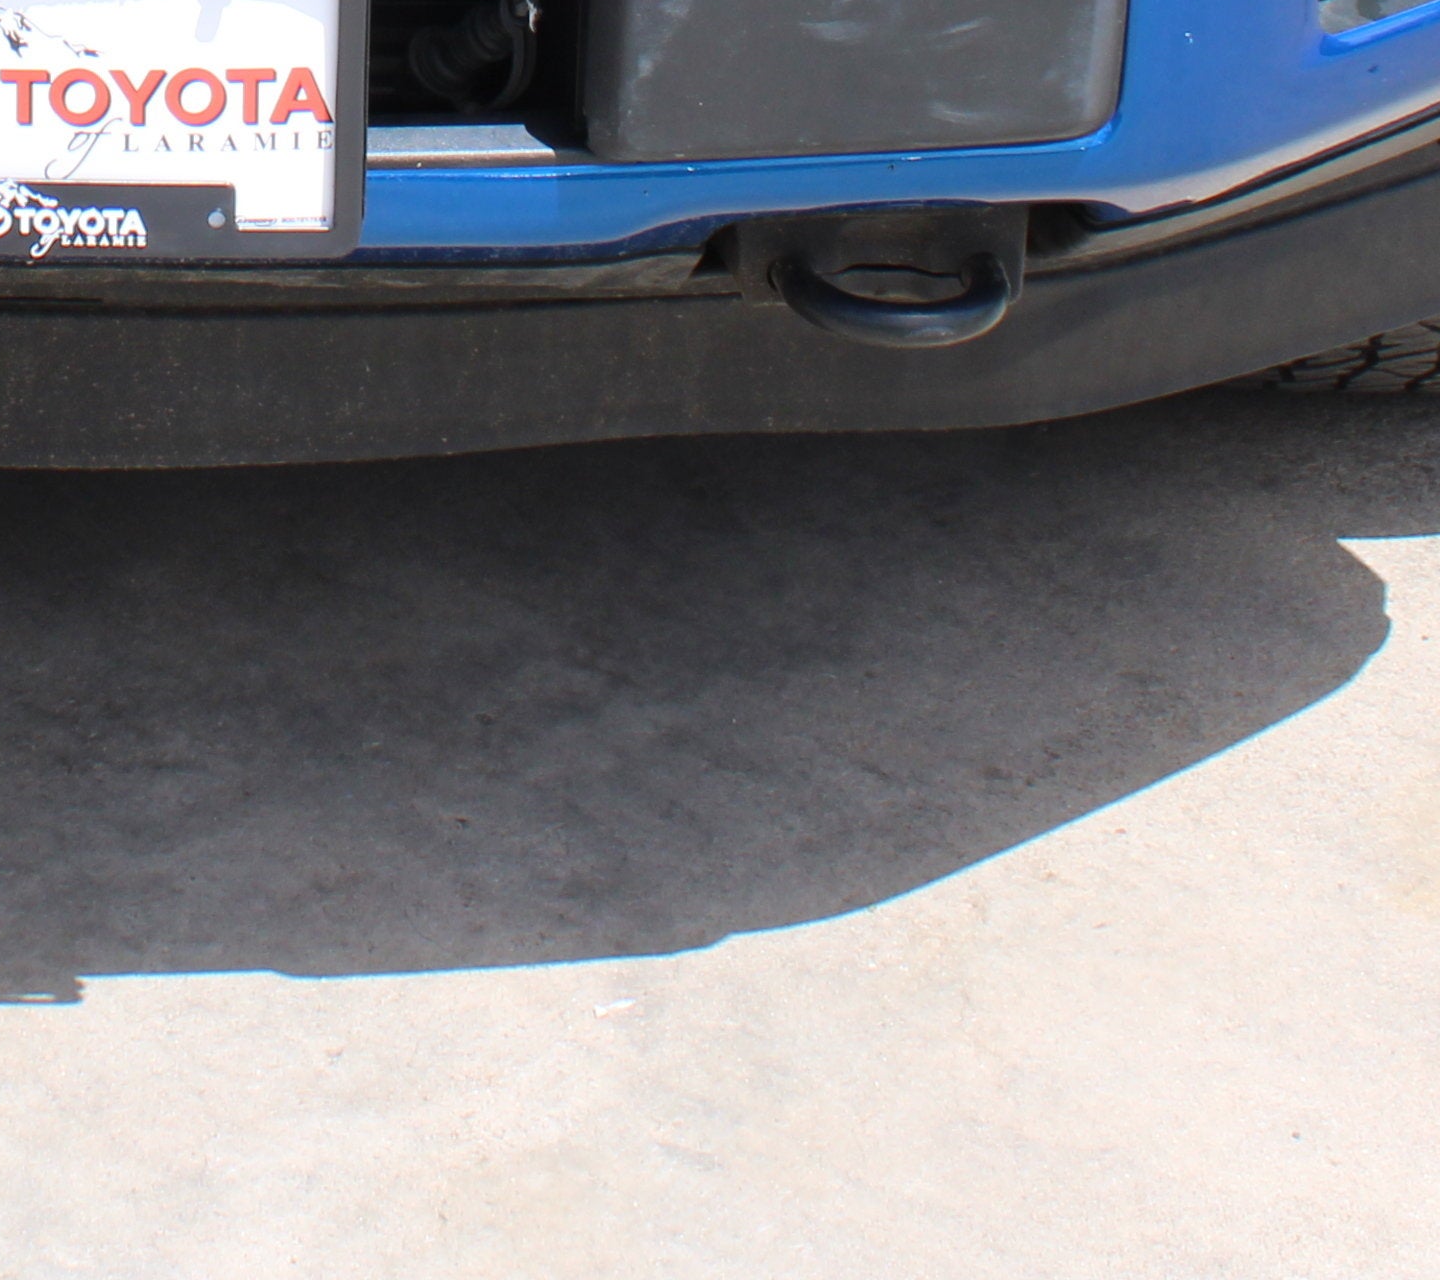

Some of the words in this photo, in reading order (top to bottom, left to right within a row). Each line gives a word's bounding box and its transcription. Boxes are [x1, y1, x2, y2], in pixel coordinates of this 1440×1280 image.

[0, 66, 335, 128] TOYOTA
[44, 117, 123, 180] of
[123, 129, 334, 153] LARAMIE
[13, 206, 148, 237] TOYOTA
[60, 234, 148, 249] LARAMIE
